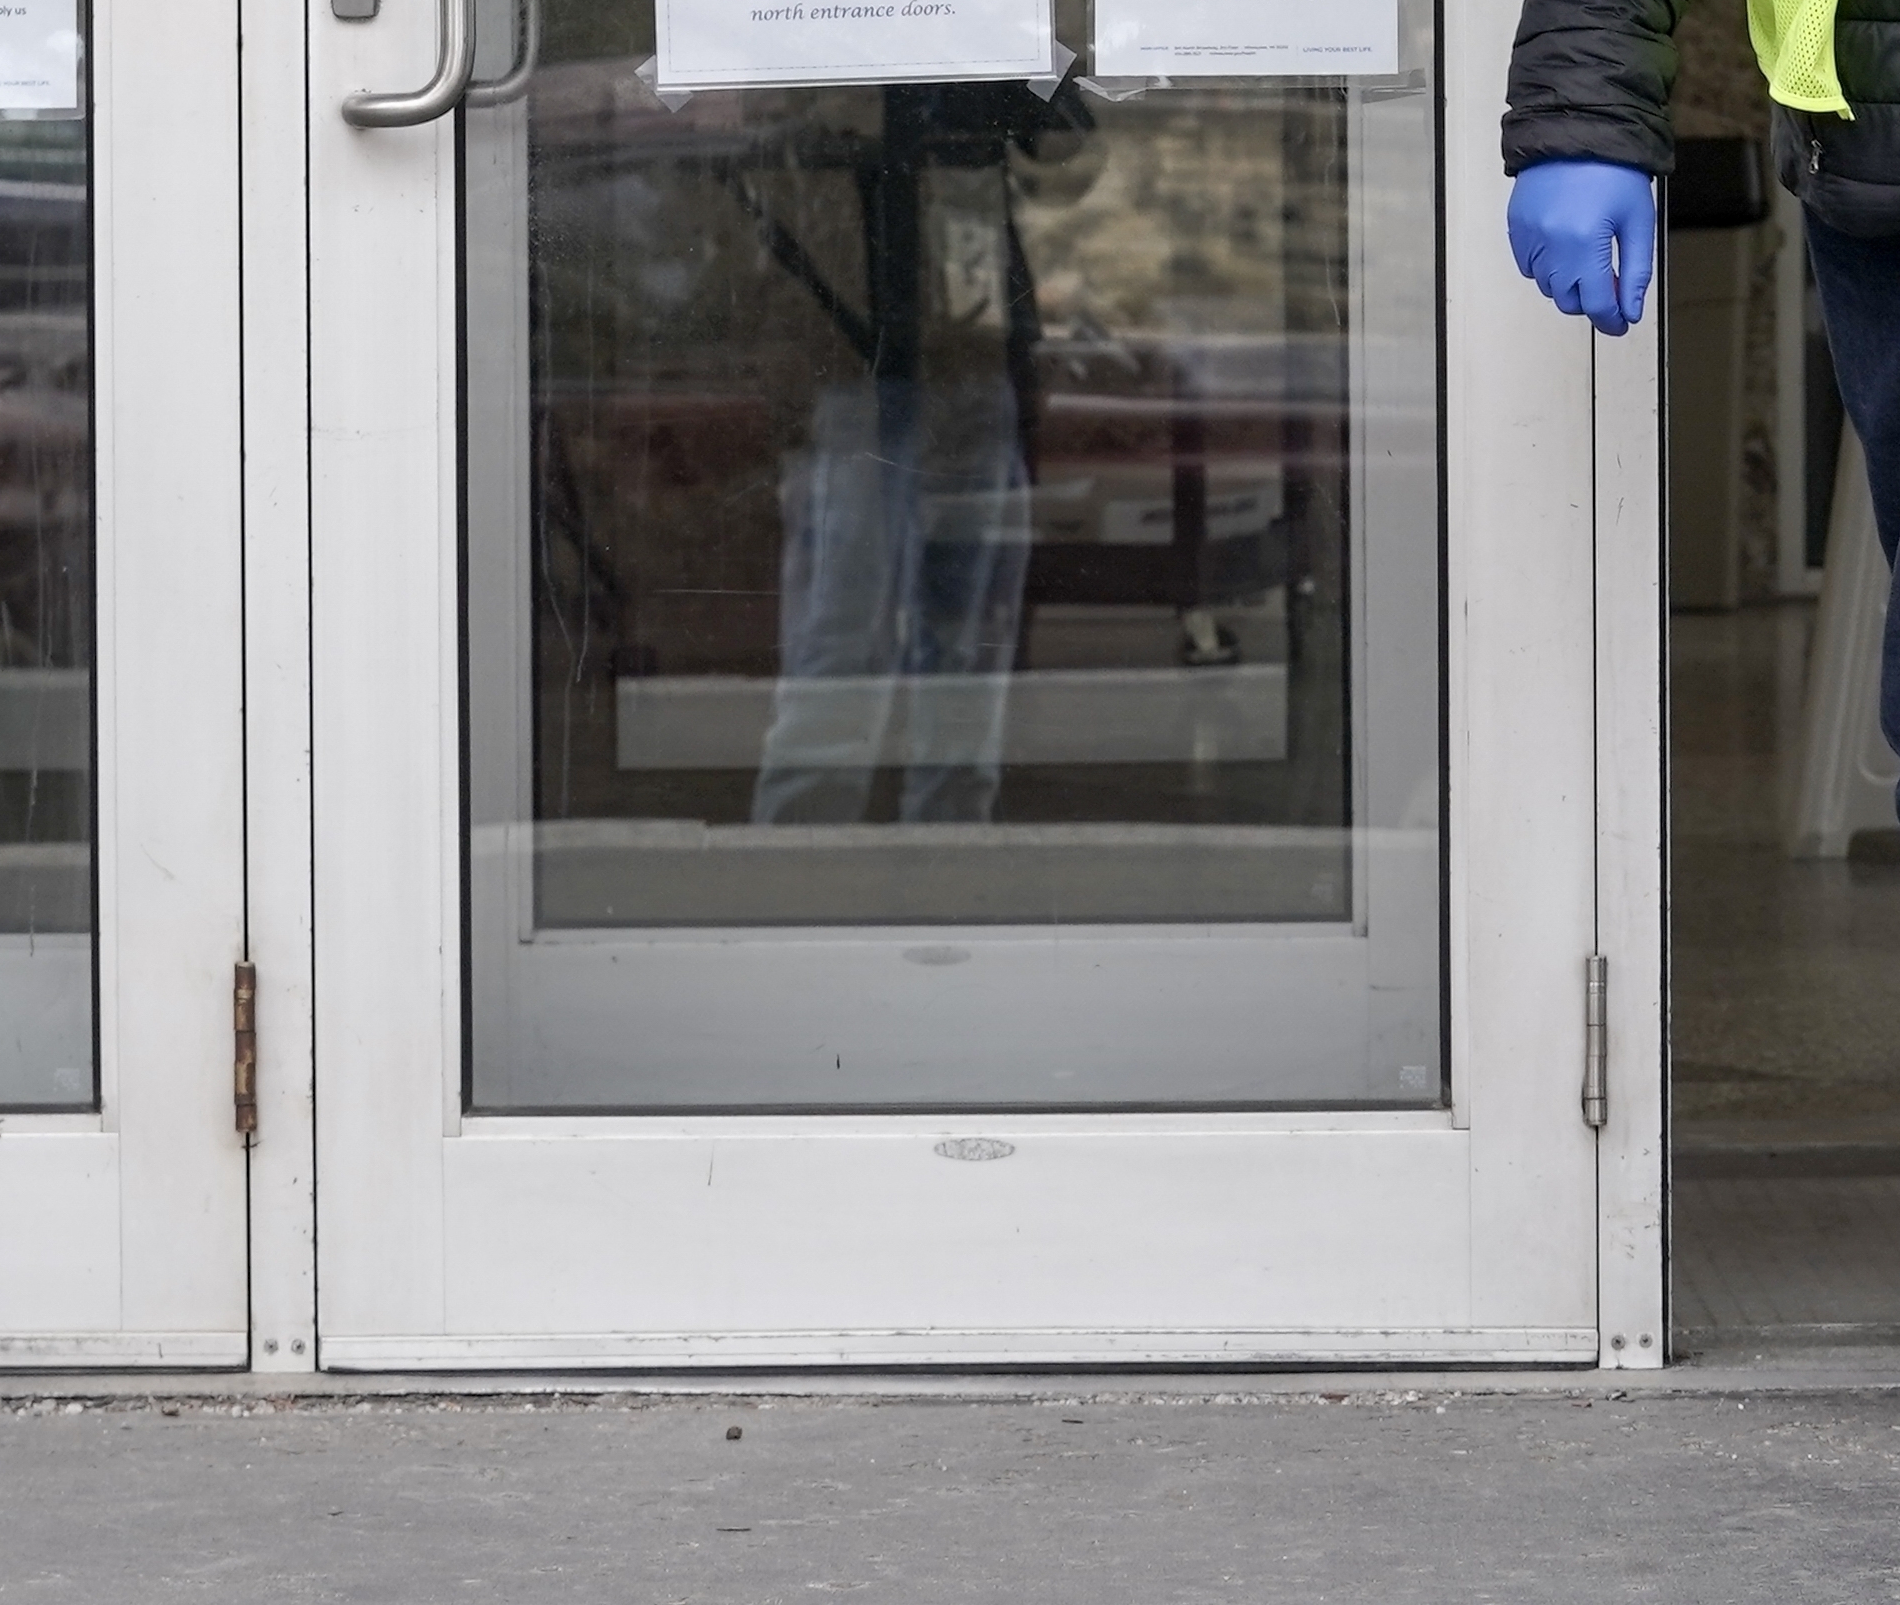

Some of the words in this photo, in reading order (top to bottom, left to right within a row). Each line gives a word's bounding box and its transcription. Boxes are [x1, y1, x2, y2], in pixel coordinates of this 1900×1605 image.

[752, 3, 803, 21] north
[811, 5, 894, 19] entrance
[901, 0, 955, 16] doors.
